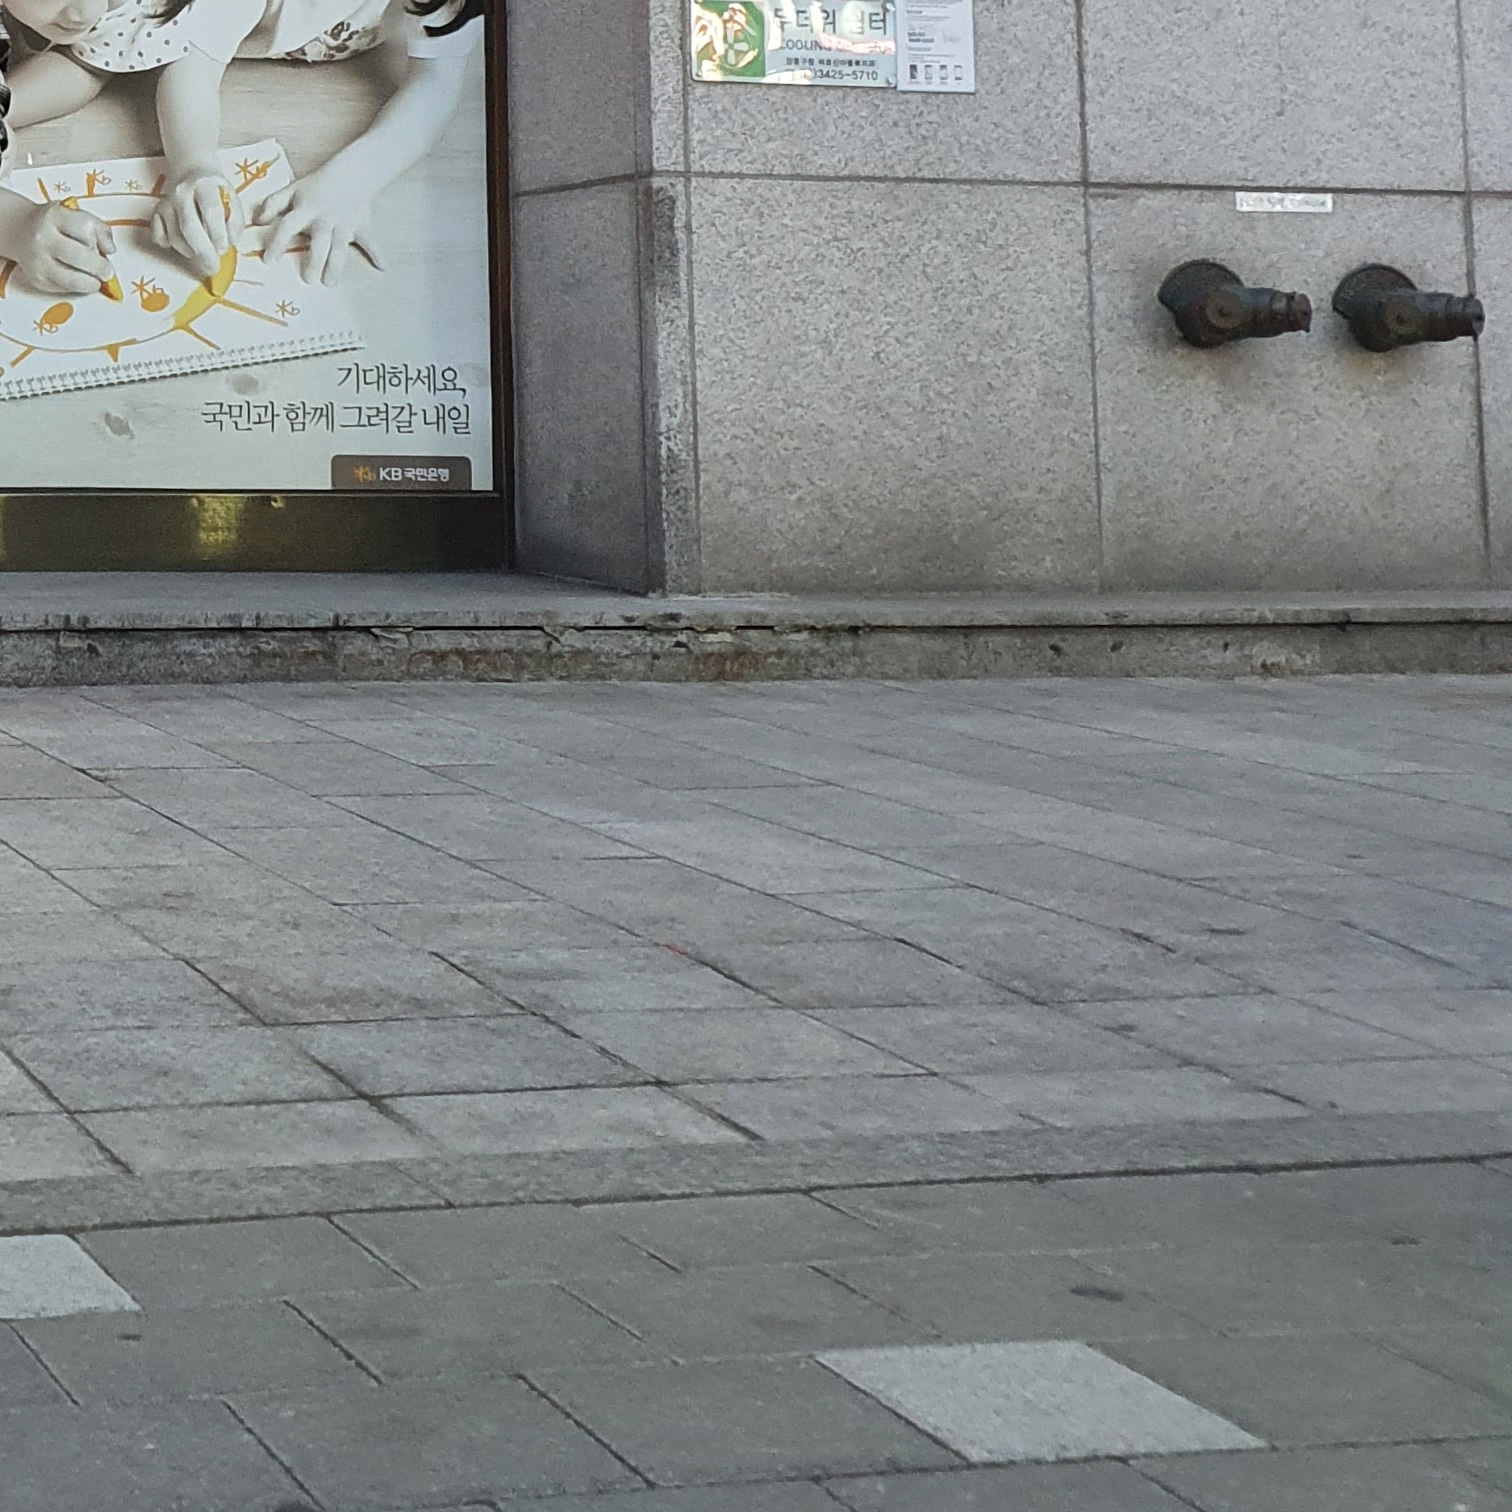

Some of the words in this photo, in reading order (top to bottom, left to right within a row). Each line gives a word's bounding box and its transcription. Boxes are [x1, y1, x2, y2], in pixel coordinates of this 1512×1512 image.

[201, 401, 280, 433] 국민과
[283, 401, 335, 434] 함께
[339, 402, 418, 434] 그려갈
[421, 403, 471, 435] 내일
